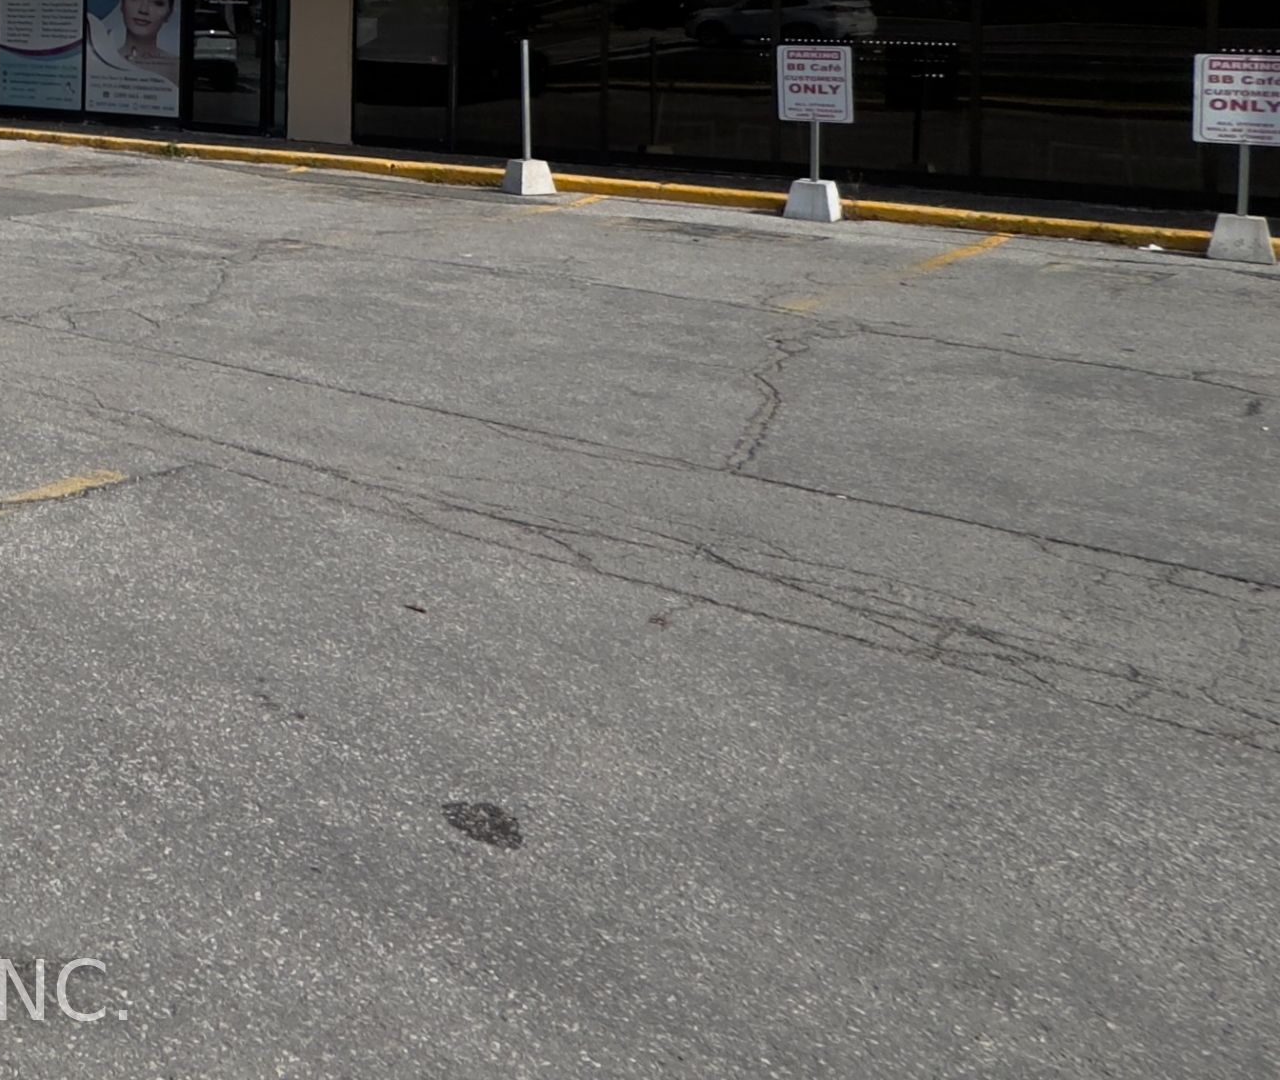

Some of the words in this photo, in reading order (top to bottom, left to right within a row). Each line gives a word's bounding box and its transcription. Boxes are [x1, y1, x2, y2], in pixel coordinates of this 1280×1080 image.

[810, 63, 842, 72] Café
[1208, 74, 1234, 84] BB
[789, 83, 841, 95] ONLY
[1209, 98, 1280, 113] ONLY
